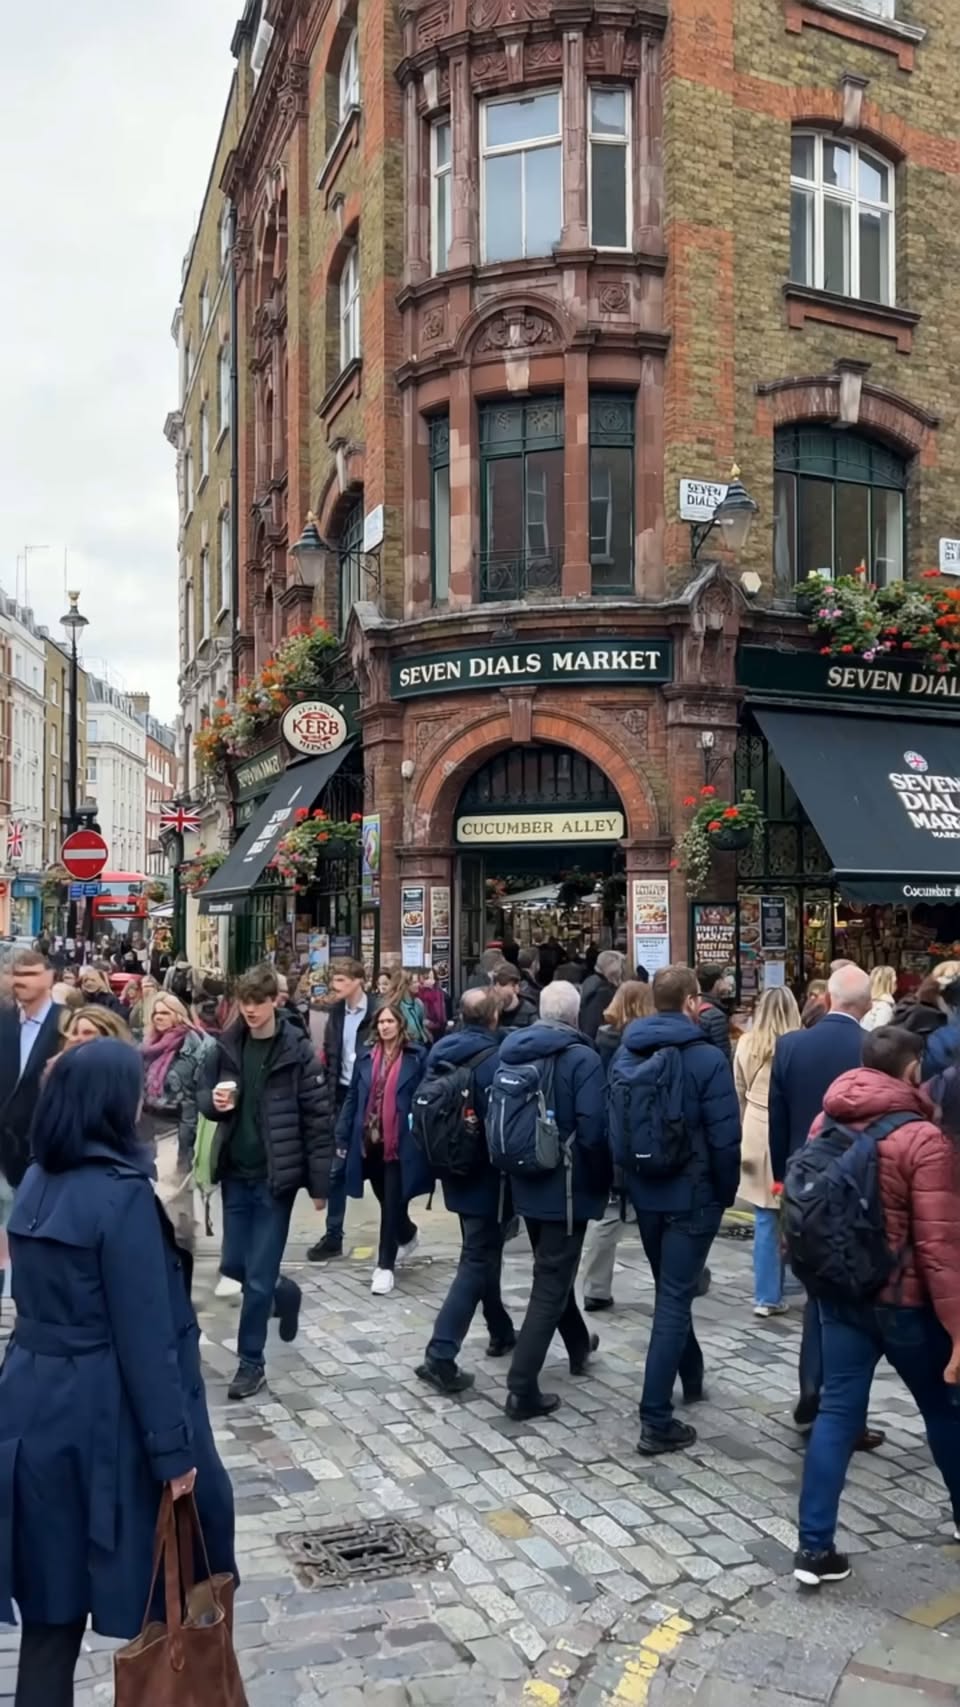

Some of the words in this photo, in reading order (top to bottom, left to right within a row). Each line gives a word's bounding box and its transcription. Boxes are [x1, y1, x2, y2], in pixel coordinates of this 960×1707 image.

[687, 483, 722, 497] SEVEN
[399, 660, 462, 687] SEVEN
[469, 653, 542, 677] DIALS
[552, 651, 661, 671] MARKET
[827, 666, 903, 692] SEVEN
[292, 719, 340, 736] KERB
[888, 773, 960, 793] SEVEN
[462, 821, 553, 836] CUCUMBER
[561, 818, 617, 833] ALLEY
